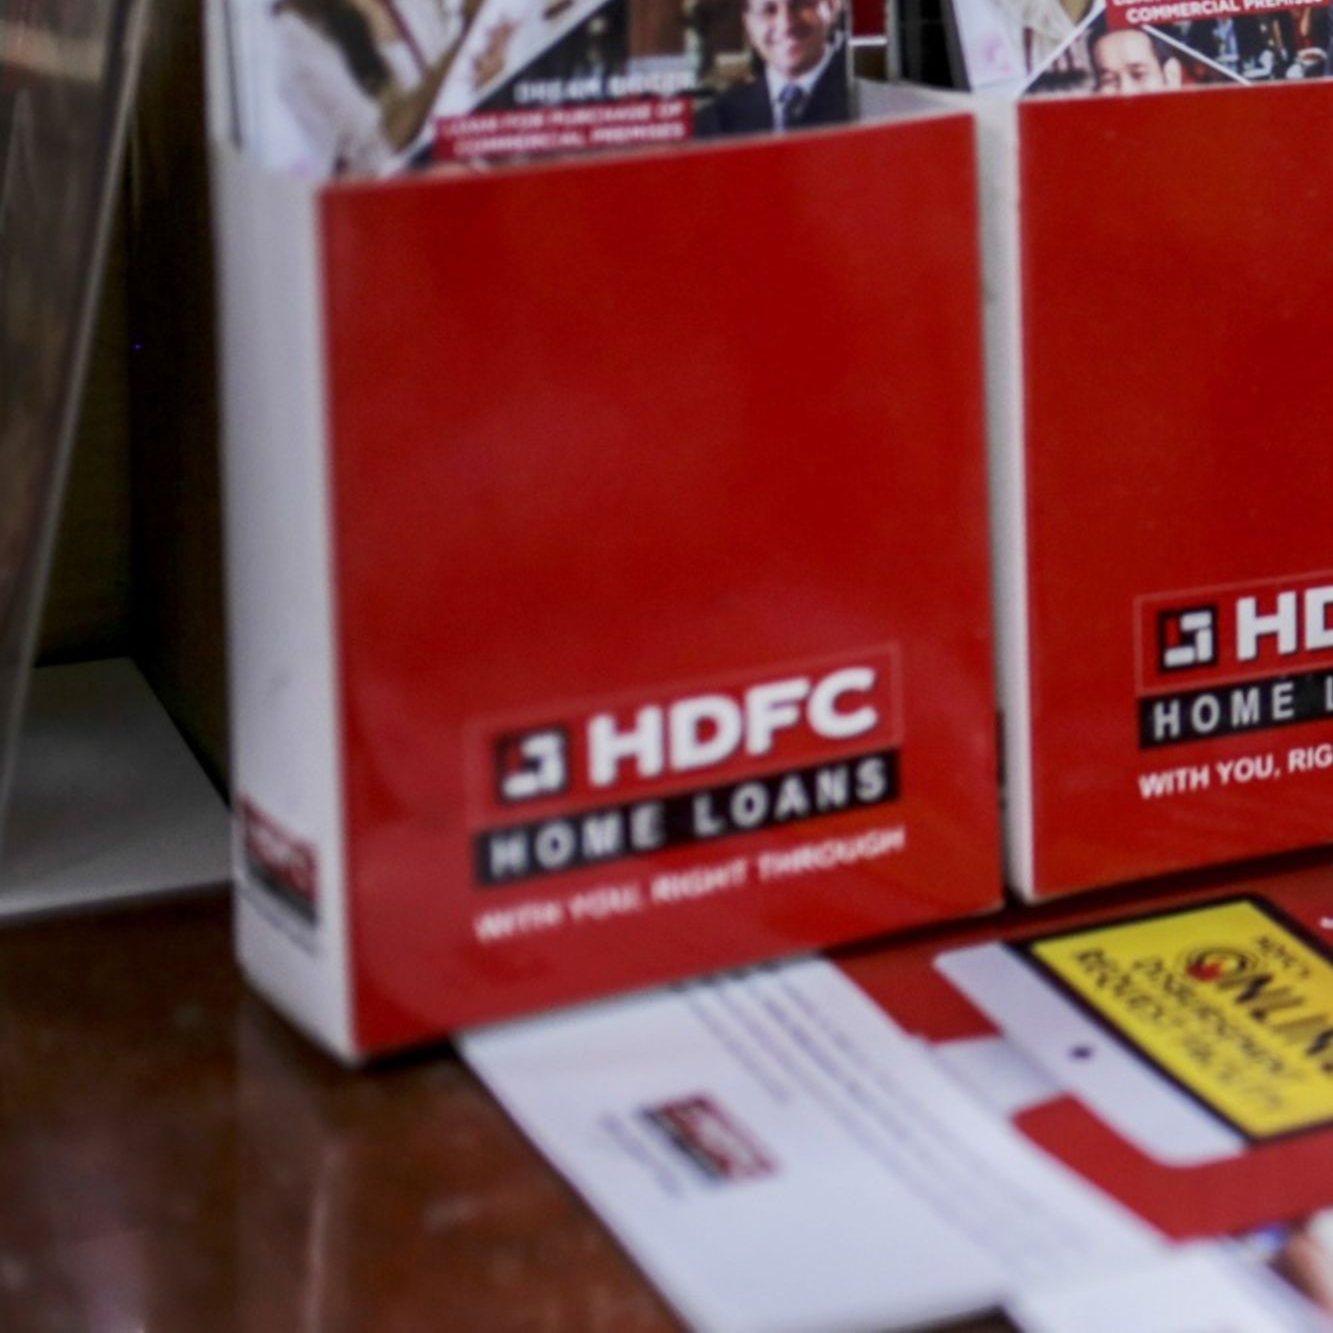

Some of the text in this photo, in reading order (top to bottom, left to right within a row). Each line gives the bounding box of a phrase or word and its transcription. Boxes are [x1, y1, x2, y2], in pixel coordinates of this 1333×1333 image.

[586, 665, 879, 788] HDFC
[1152, 681, 1296, 741] HOME
[488, 757, 889, 880] HOME LOANS
[1138, 764, 1210, 801] WITH
[1214, 753, 1282, 787] YOU,
